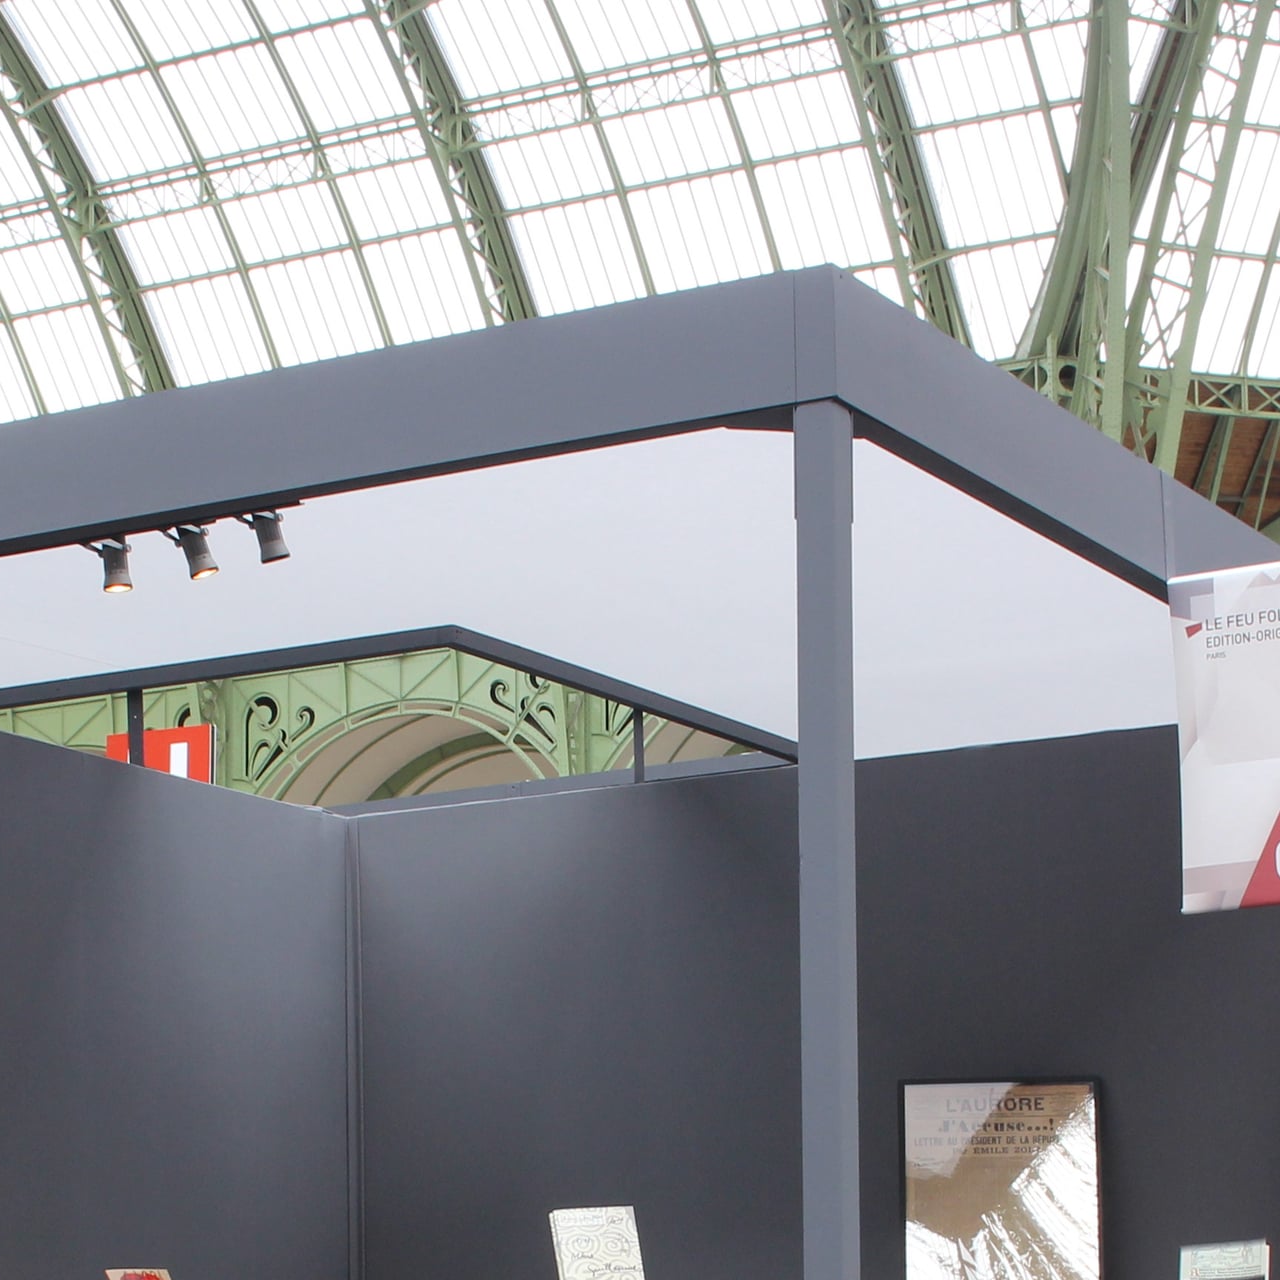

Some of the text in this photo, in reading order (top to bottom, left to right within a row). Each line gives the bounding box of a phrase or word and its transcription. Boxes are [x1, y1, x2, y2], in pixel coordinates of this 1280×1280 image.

[1205, 617, 1223, 631] LE
[1226, 612, 1254, 628] FEU
[946, 1097, 1045, 1112] L'AURORE
[1006, 1134, 1017, 1144] DE
[1020, 1134, 1030, 1144] LA
